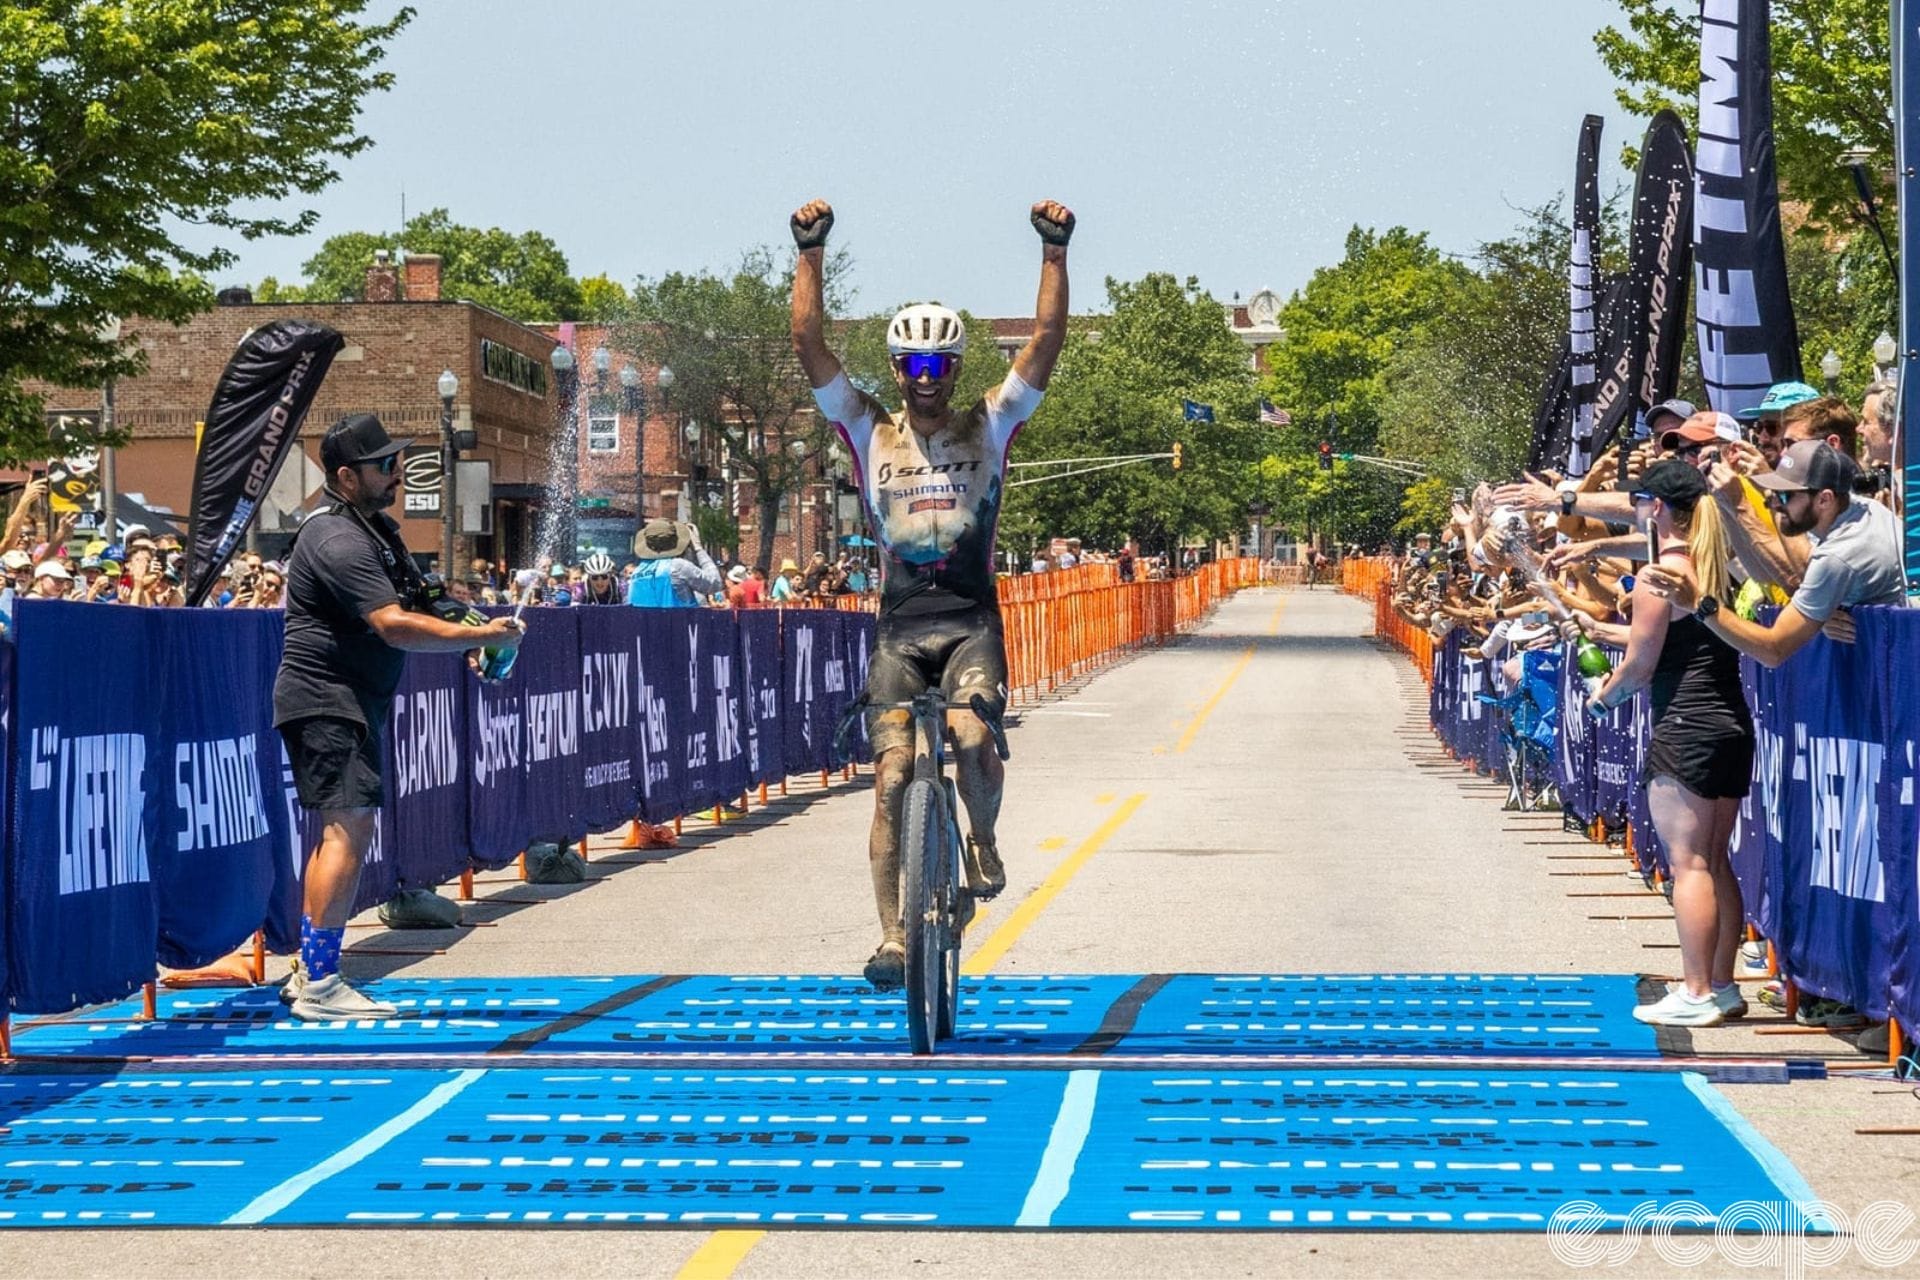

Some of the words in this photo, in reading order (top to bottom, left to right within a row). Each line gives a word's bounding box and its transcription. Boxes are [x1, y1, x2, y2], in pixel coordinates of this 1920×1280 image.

[244, 406, 289, 498] GRAND
[282, 351, 316, 406] PRIX
[894, 461, 982, 478] SCOTT
[893, 483, 967, 499] SHIMANO
[404, 494, 439, 510] ESU
